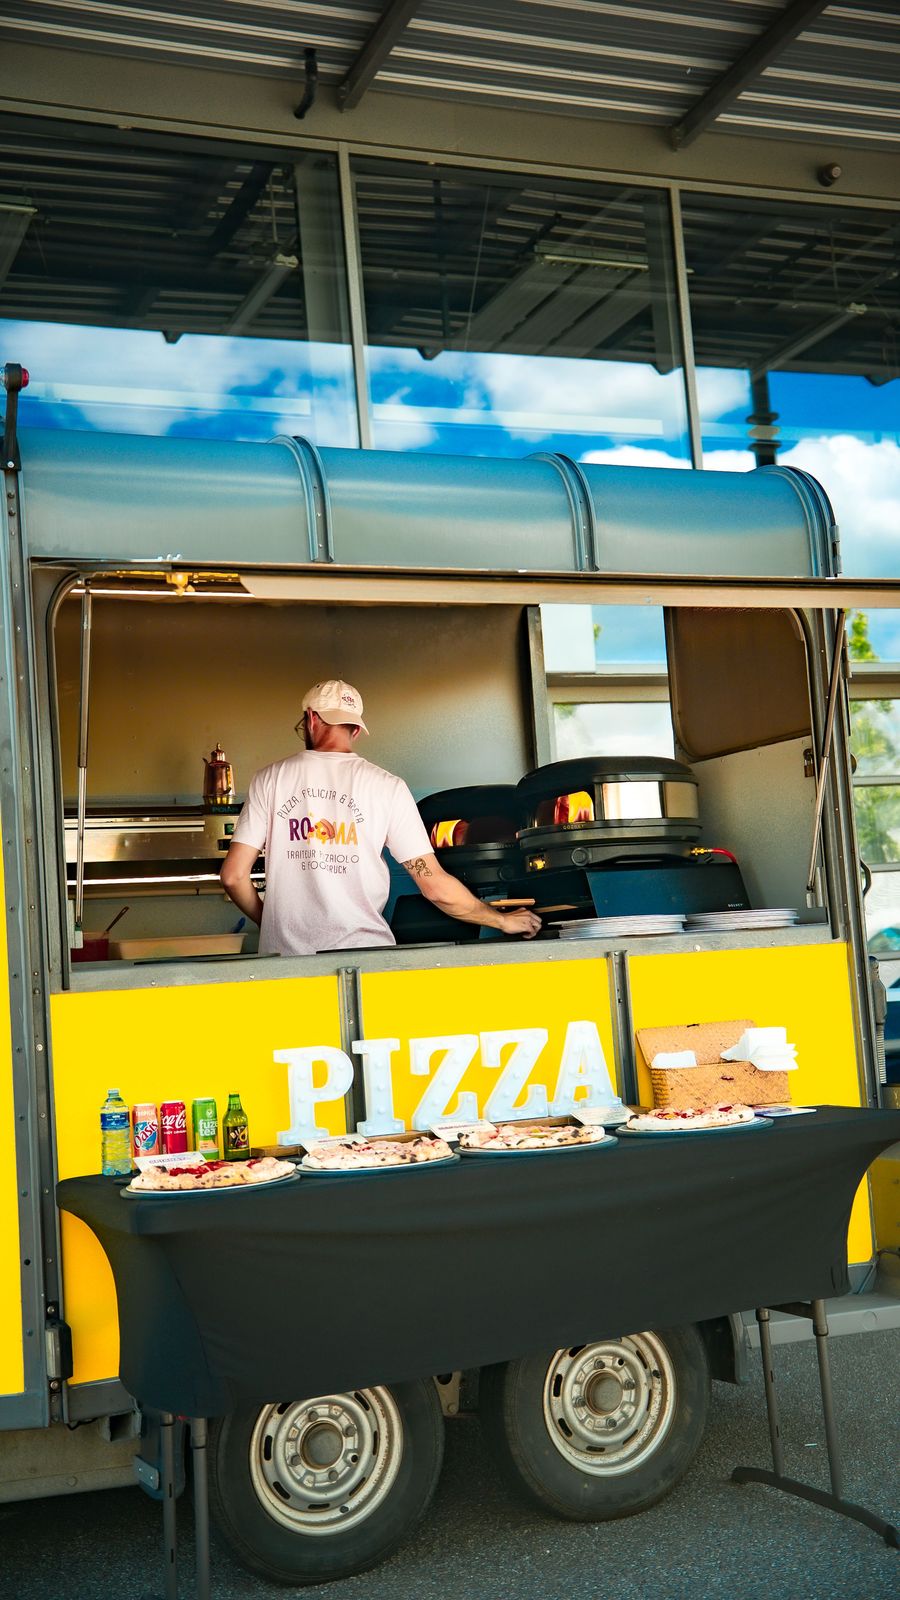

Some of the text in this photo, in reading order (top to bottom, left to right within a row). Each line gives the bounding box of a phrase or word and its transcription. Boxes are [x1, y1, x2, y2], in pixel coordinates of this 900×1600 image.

[287, 849, 316, 859] TRAITEUR
[273, 1020, 622, 1146] PIZZA
[134, 1119, 158, 1149] Oasis
[200, 1127, 215, 1137] tea
